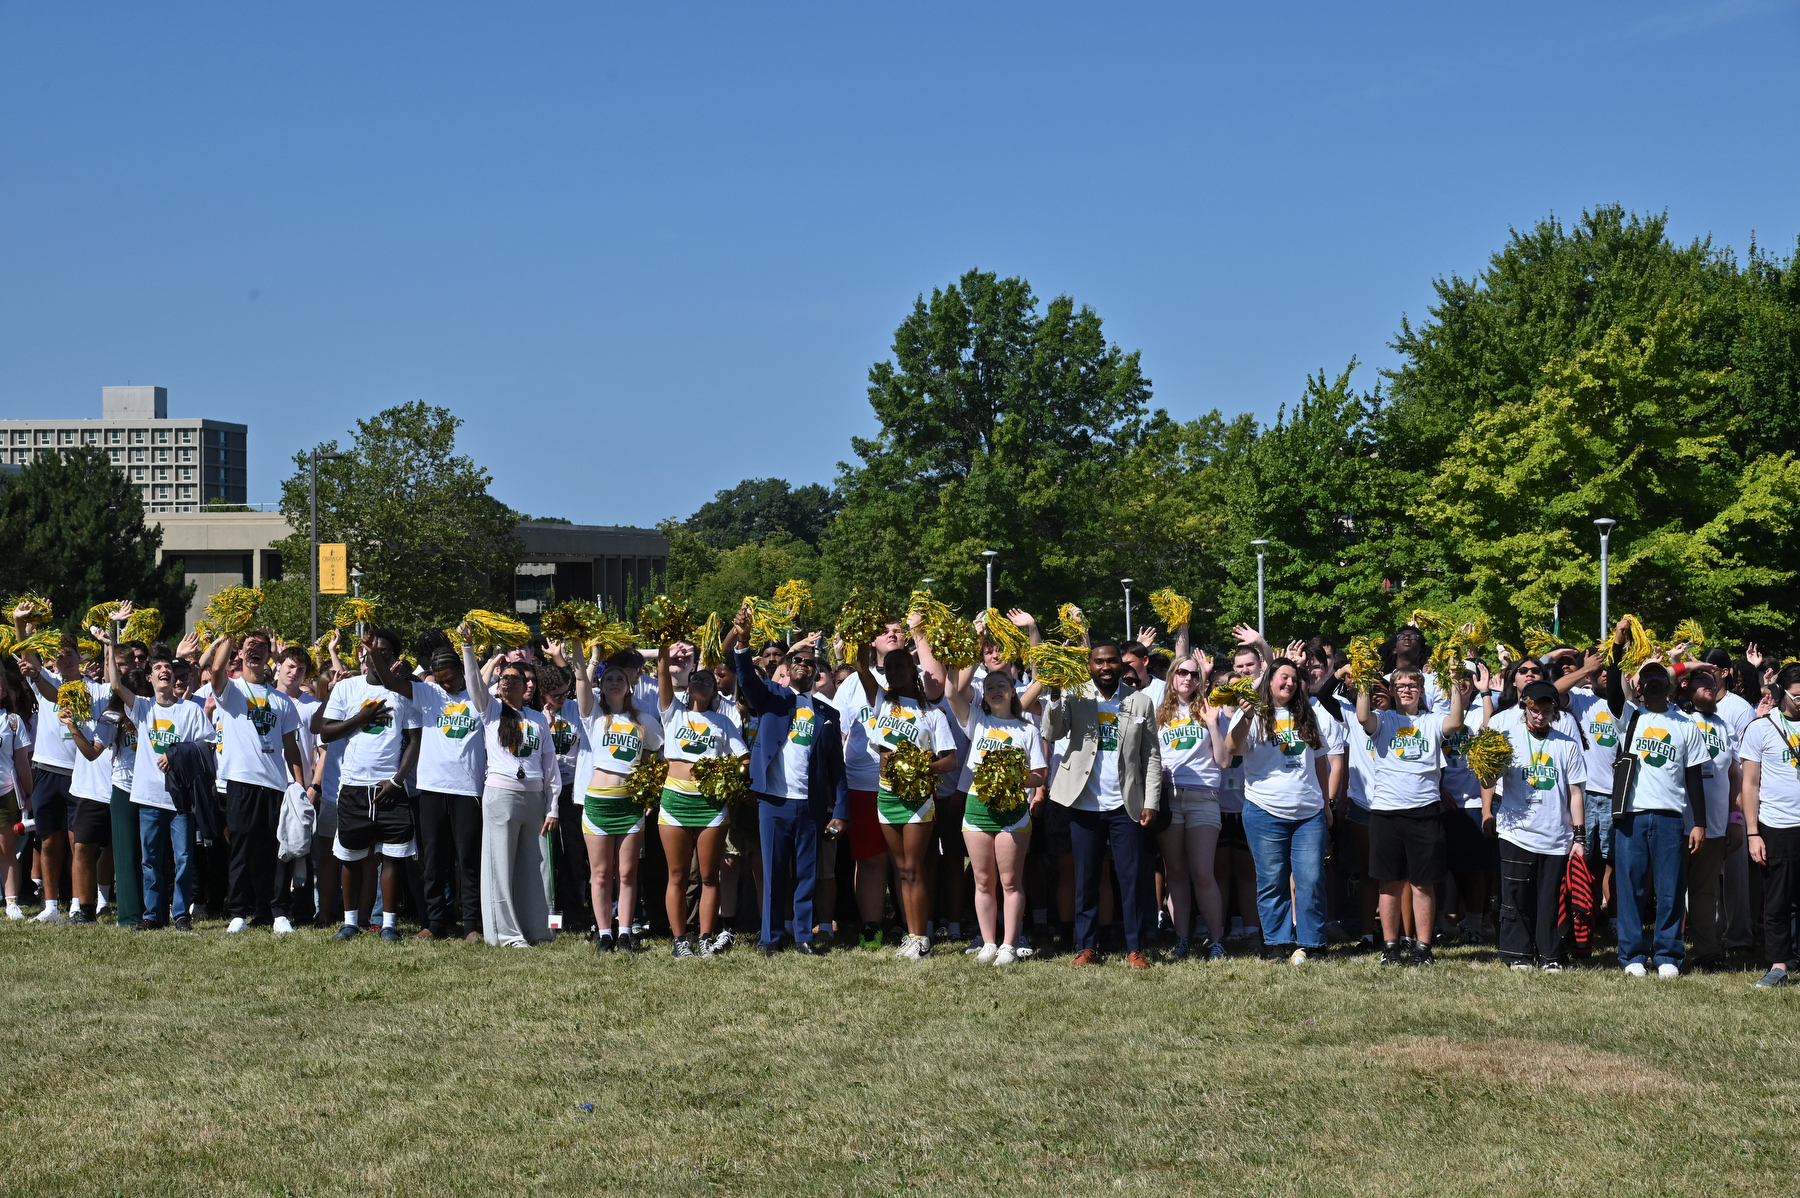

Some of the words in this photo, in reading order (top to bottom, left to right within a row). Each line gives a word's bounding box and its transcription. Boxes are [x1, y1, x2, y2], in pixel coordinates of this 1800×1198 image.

[437, 716, 476, 731] OSWEGO
[878, 716, 919, 742] OSWEGO
[602, 731, 642, 755] OSWEGO
[675, 727, 716, 749] OSWEGO
[1163, 727, 1203, 745] OSWEGO
[1636, 739, 1676, 762] OSWEGO
[1522, 766, 1559, 783] OSWEGO
